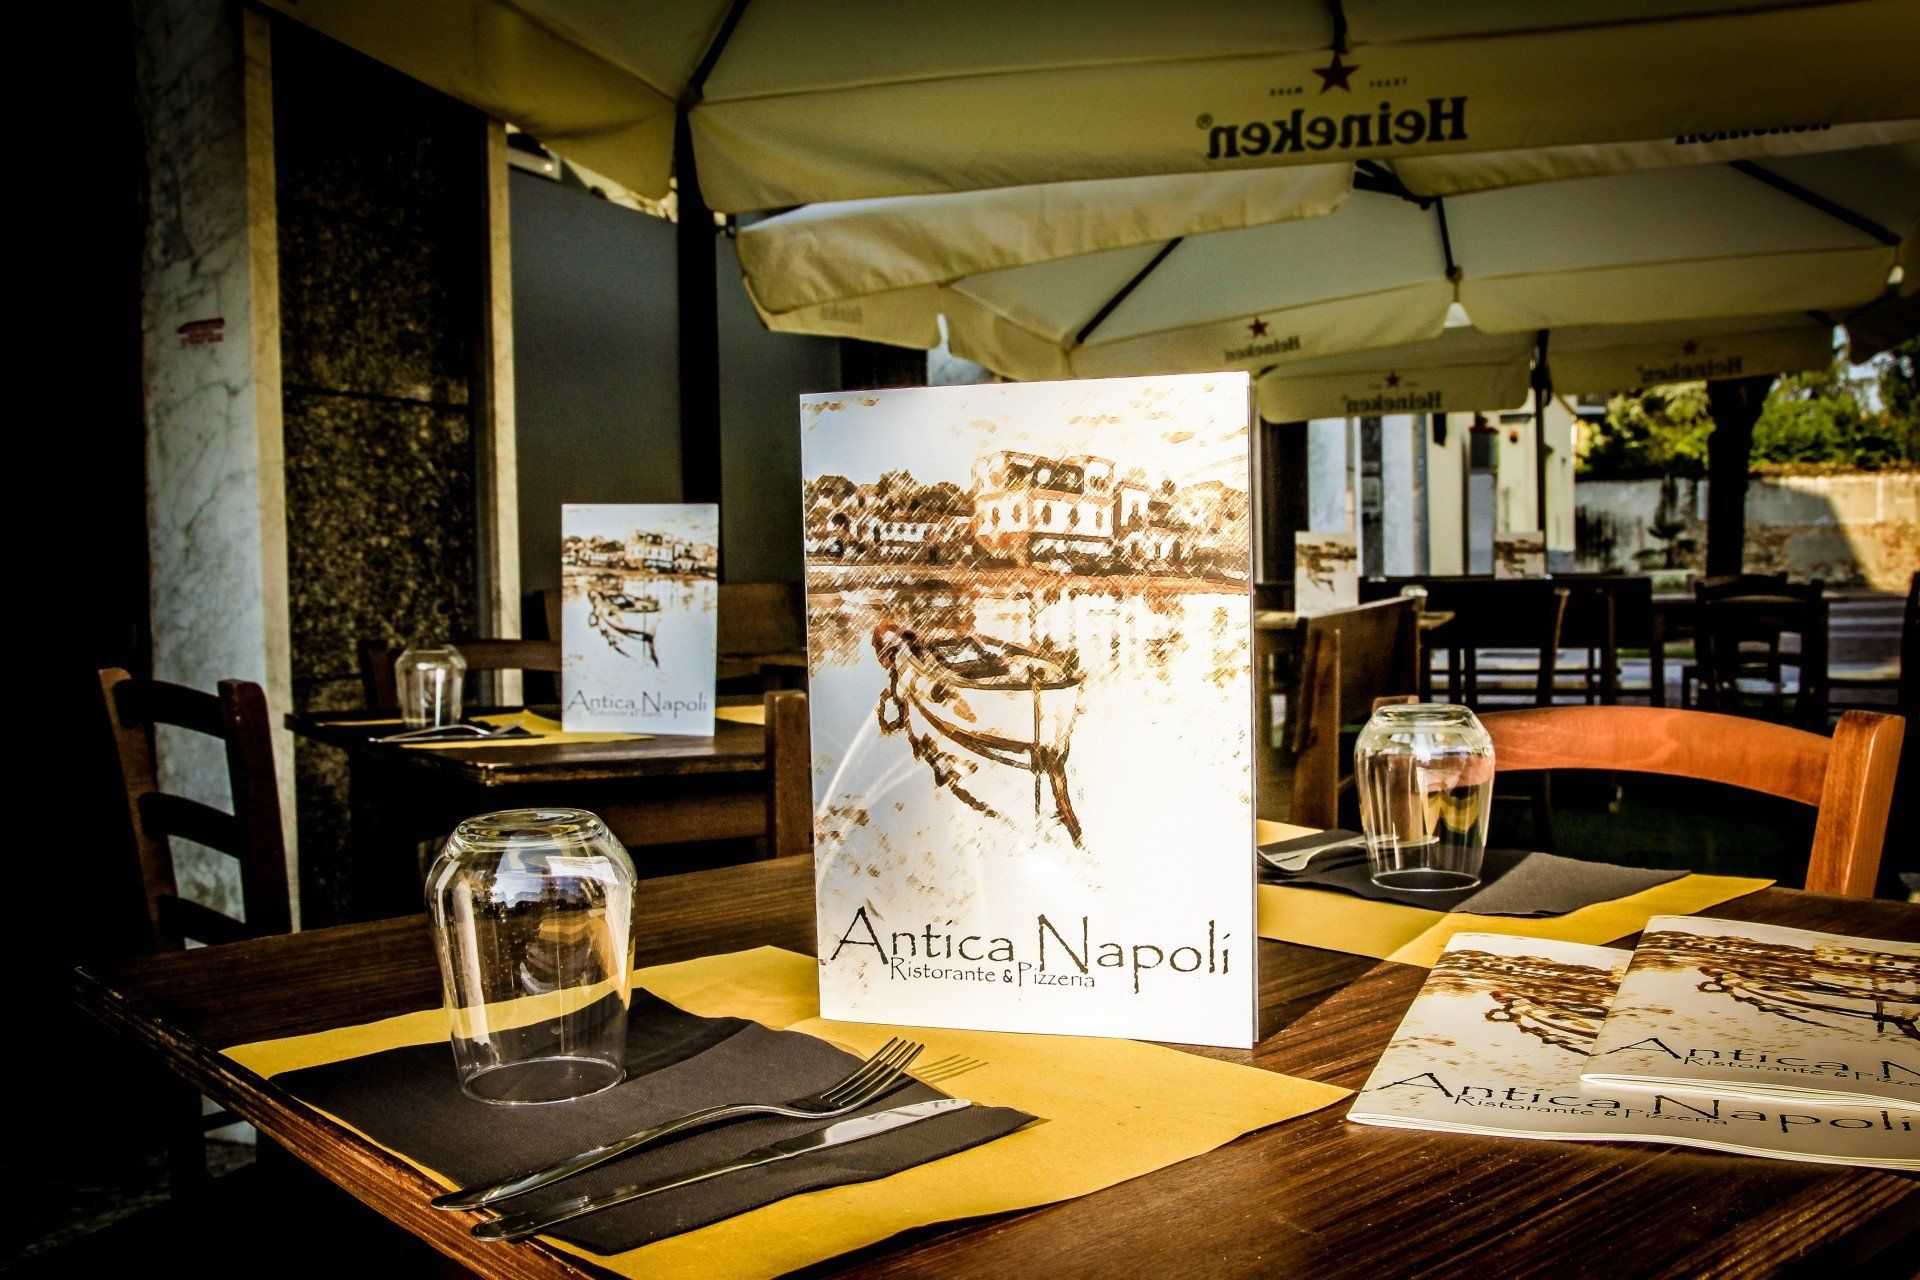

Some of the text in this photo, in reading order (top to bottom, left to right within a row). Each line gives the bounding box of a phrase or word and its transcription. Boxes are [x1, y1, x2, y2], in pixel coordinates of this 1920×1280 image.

[567, 690, 635, 711] Antica
[642, 691, 707, 719] Napoli
[830, 905, 1231, 994] Antica Napoli
[890, 956, 1096, 988] Ristorante & Pizzeria
[1606, 1037, 1850, 1072] Antica
[1683, 1056, 1825, 1076] Ristorante
[1376, 1072, 1913, 1134] Antica Napoli
[1453, 1094, 1595, 1116] Ristorante
[1624, 1109, 1728, 1125] Pizzeria
